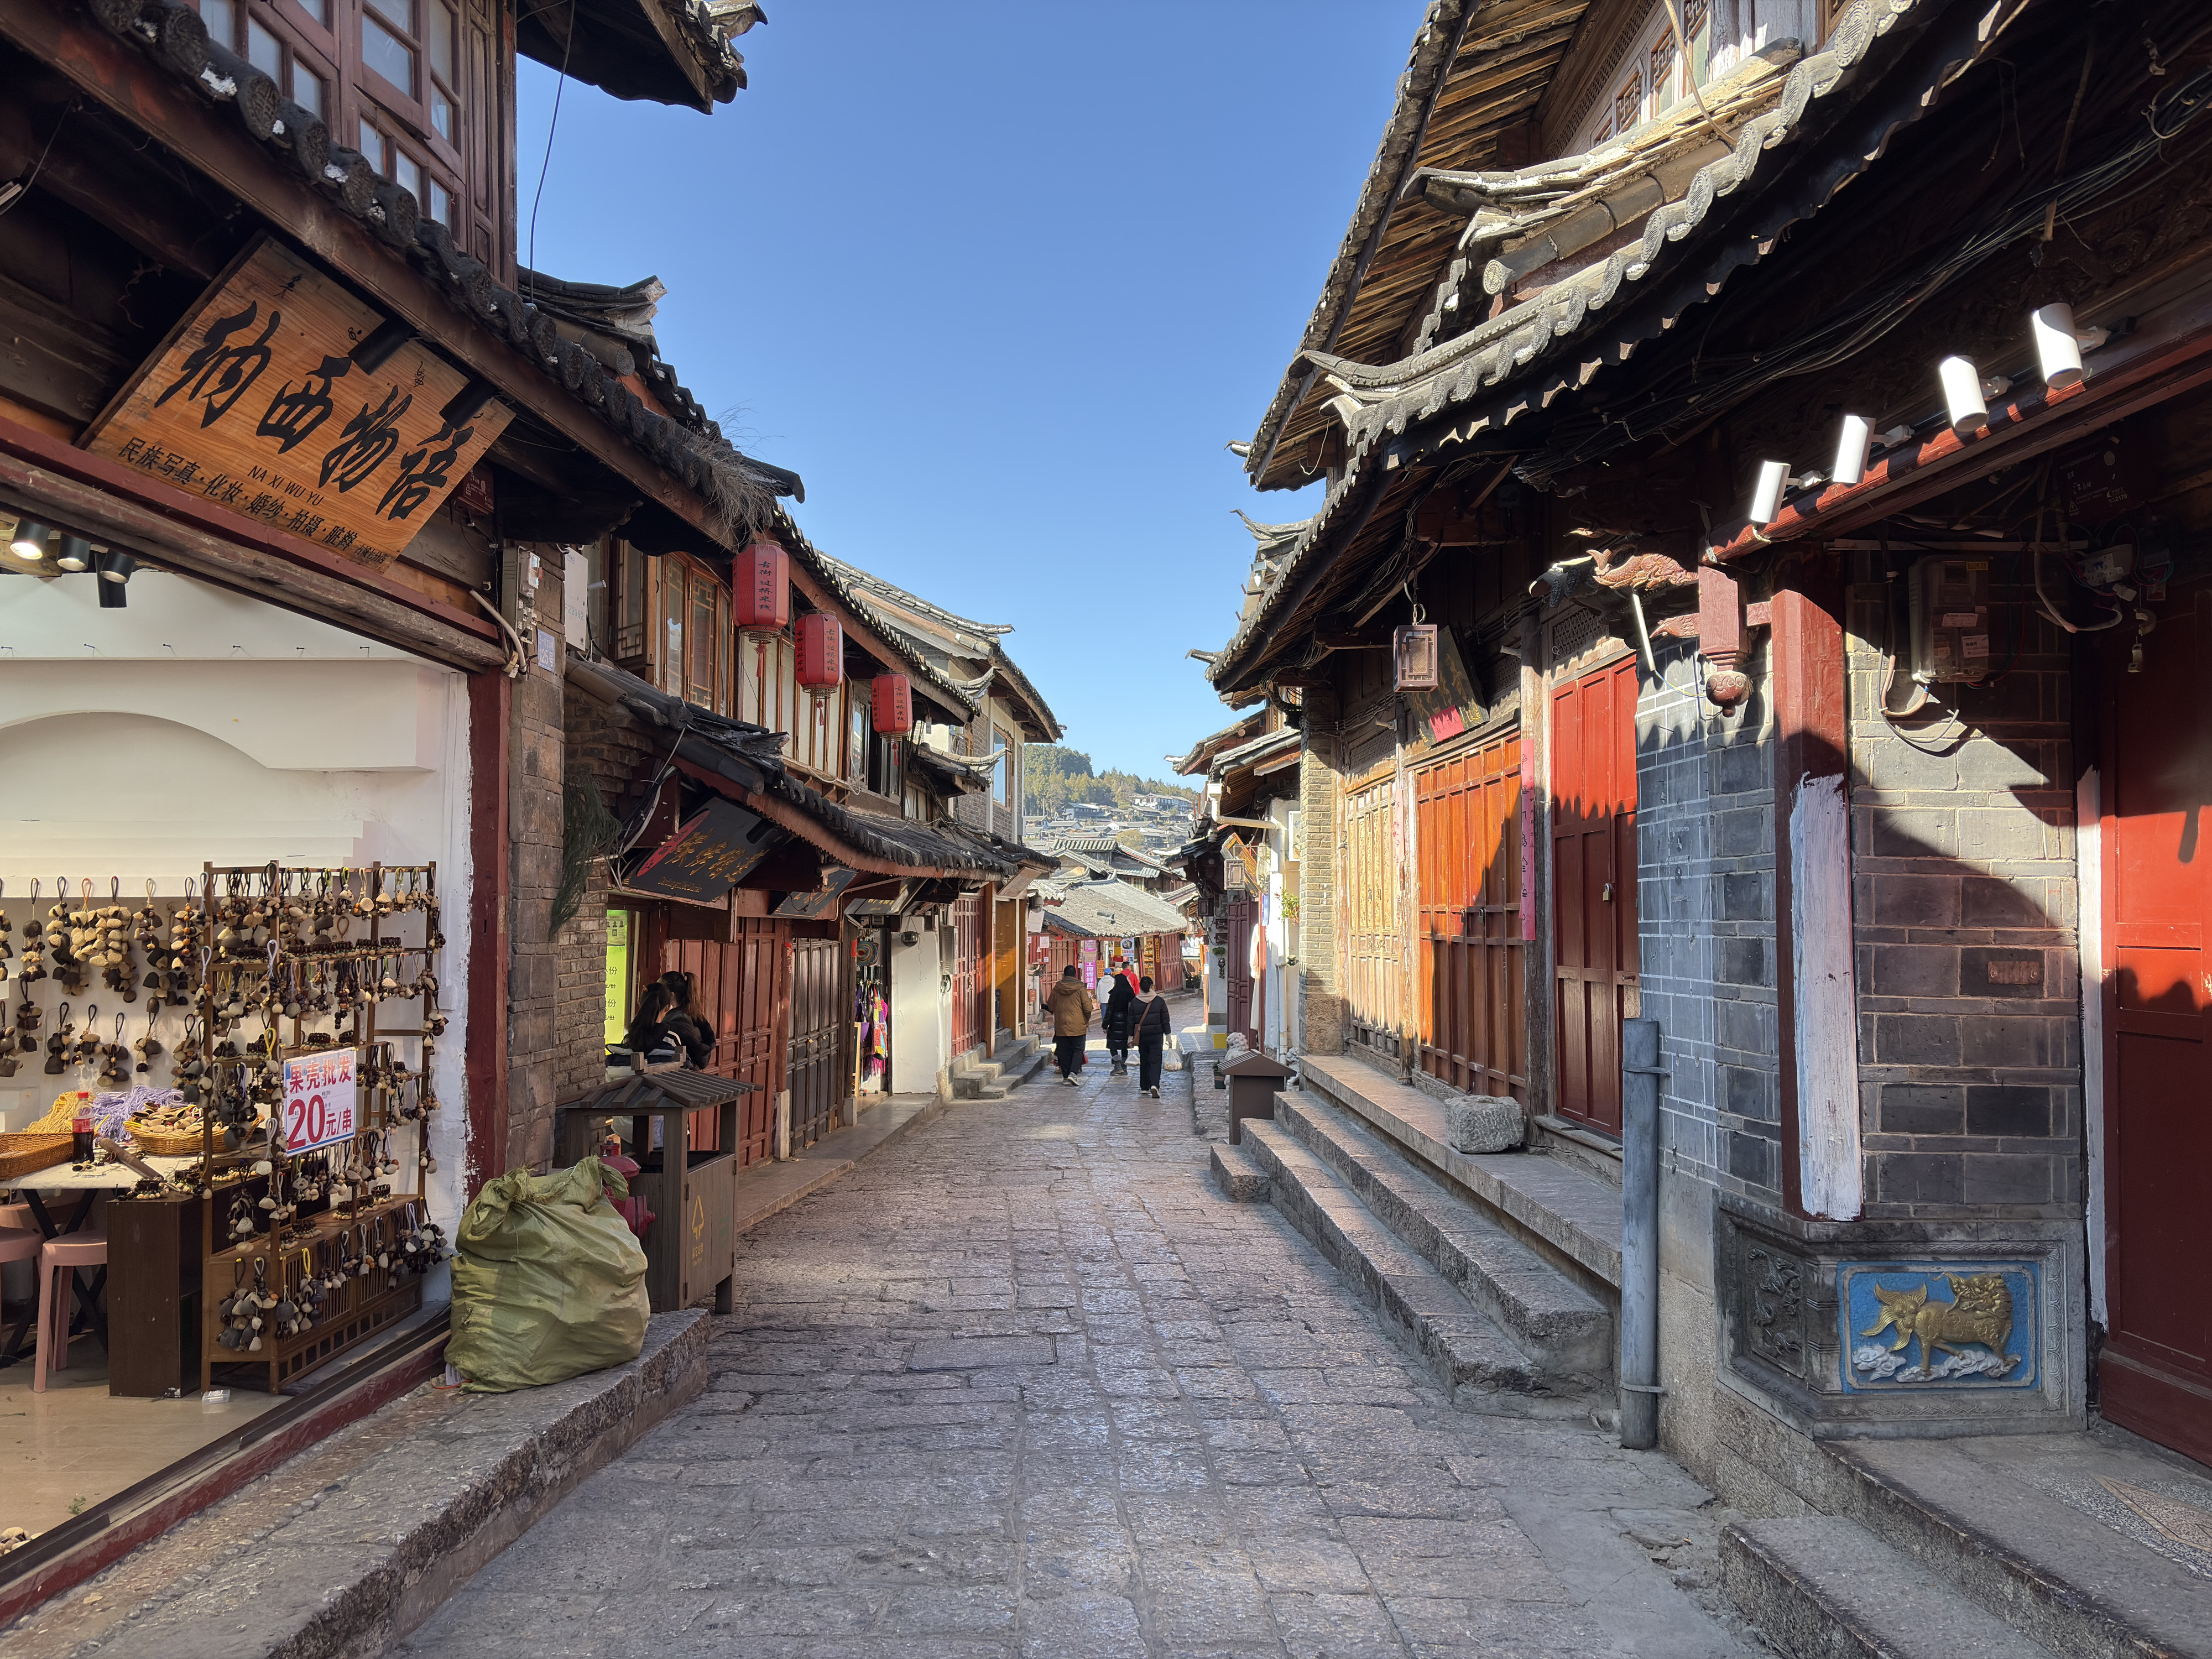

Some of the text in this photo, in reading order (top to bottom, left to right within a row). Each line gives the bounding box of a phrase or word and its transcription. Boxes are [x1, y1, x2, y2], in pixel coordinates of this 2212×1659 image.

[247, 465, 325, 506] NA XI WU YU
[540, 647, 554, 667] 125号
[289, 1055, 352, 1094] 果壳批发
[287, 1094, 352, 1151] 20元/串
